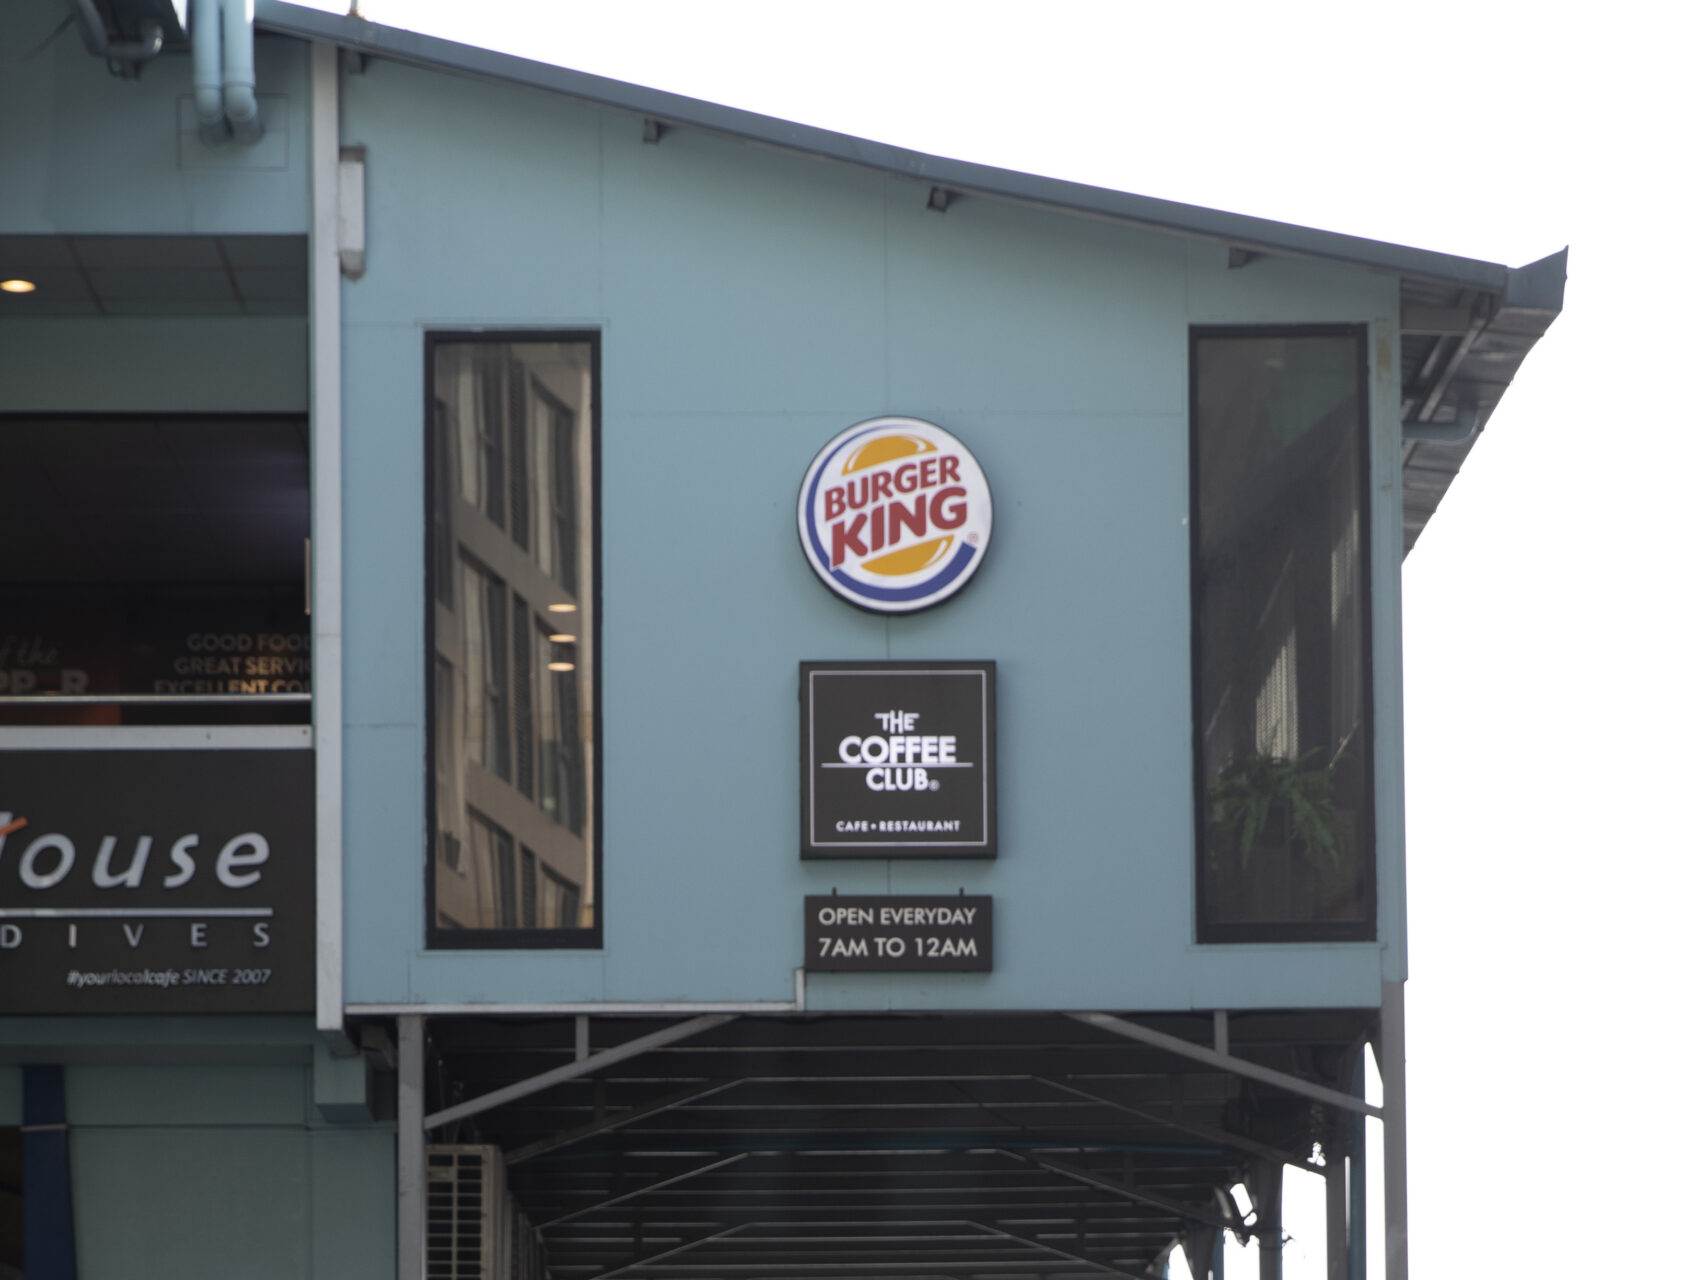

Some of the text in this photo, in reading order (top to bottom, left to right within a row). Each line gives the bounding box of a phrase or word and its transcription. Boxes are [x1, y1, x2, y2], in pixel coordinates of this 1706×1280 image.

[825, 455, 961, 522] BURGER
[831, 486, 968, 568] KING
[186, 633, 254, 652] GOOD
[173, 656, 242, 676] GREAT
[874, 710, 920, 734] THE
[838, 735, 957, 764] COFFEE
[835, 820, 961, 832] CAFE RESTAURANT
[818, 907, 977, 926] OPEN EVERYDAY
[818, 937, 978, 957] 7AM TO 12AM
[66, 968, 272, 988] #yourlocalcafe SINCE 2007
